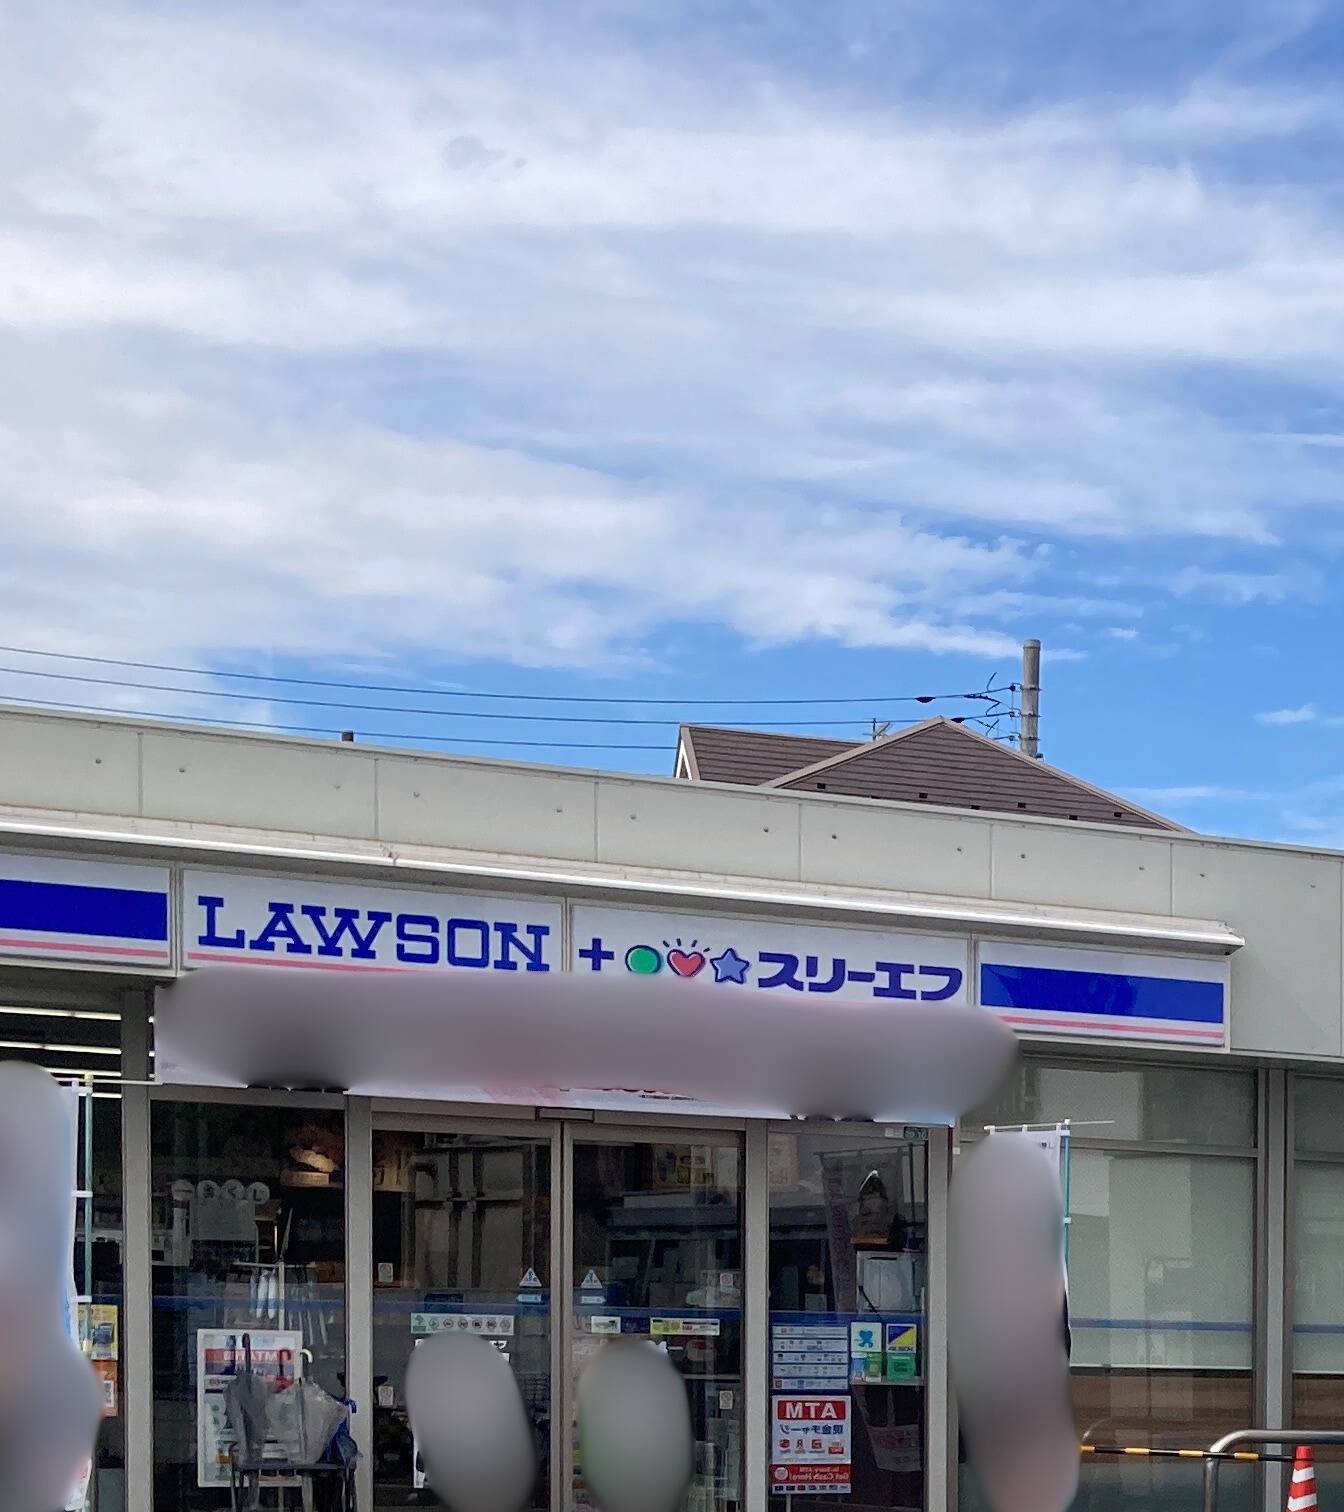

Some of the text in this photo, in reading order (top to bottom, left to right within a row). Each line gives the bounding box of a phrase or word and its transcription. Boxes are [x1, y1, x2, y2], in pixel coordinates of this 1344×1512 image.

[198, 896, 550, 972] LAWSON
[757, 951, 963, 1001] スリーエフ
